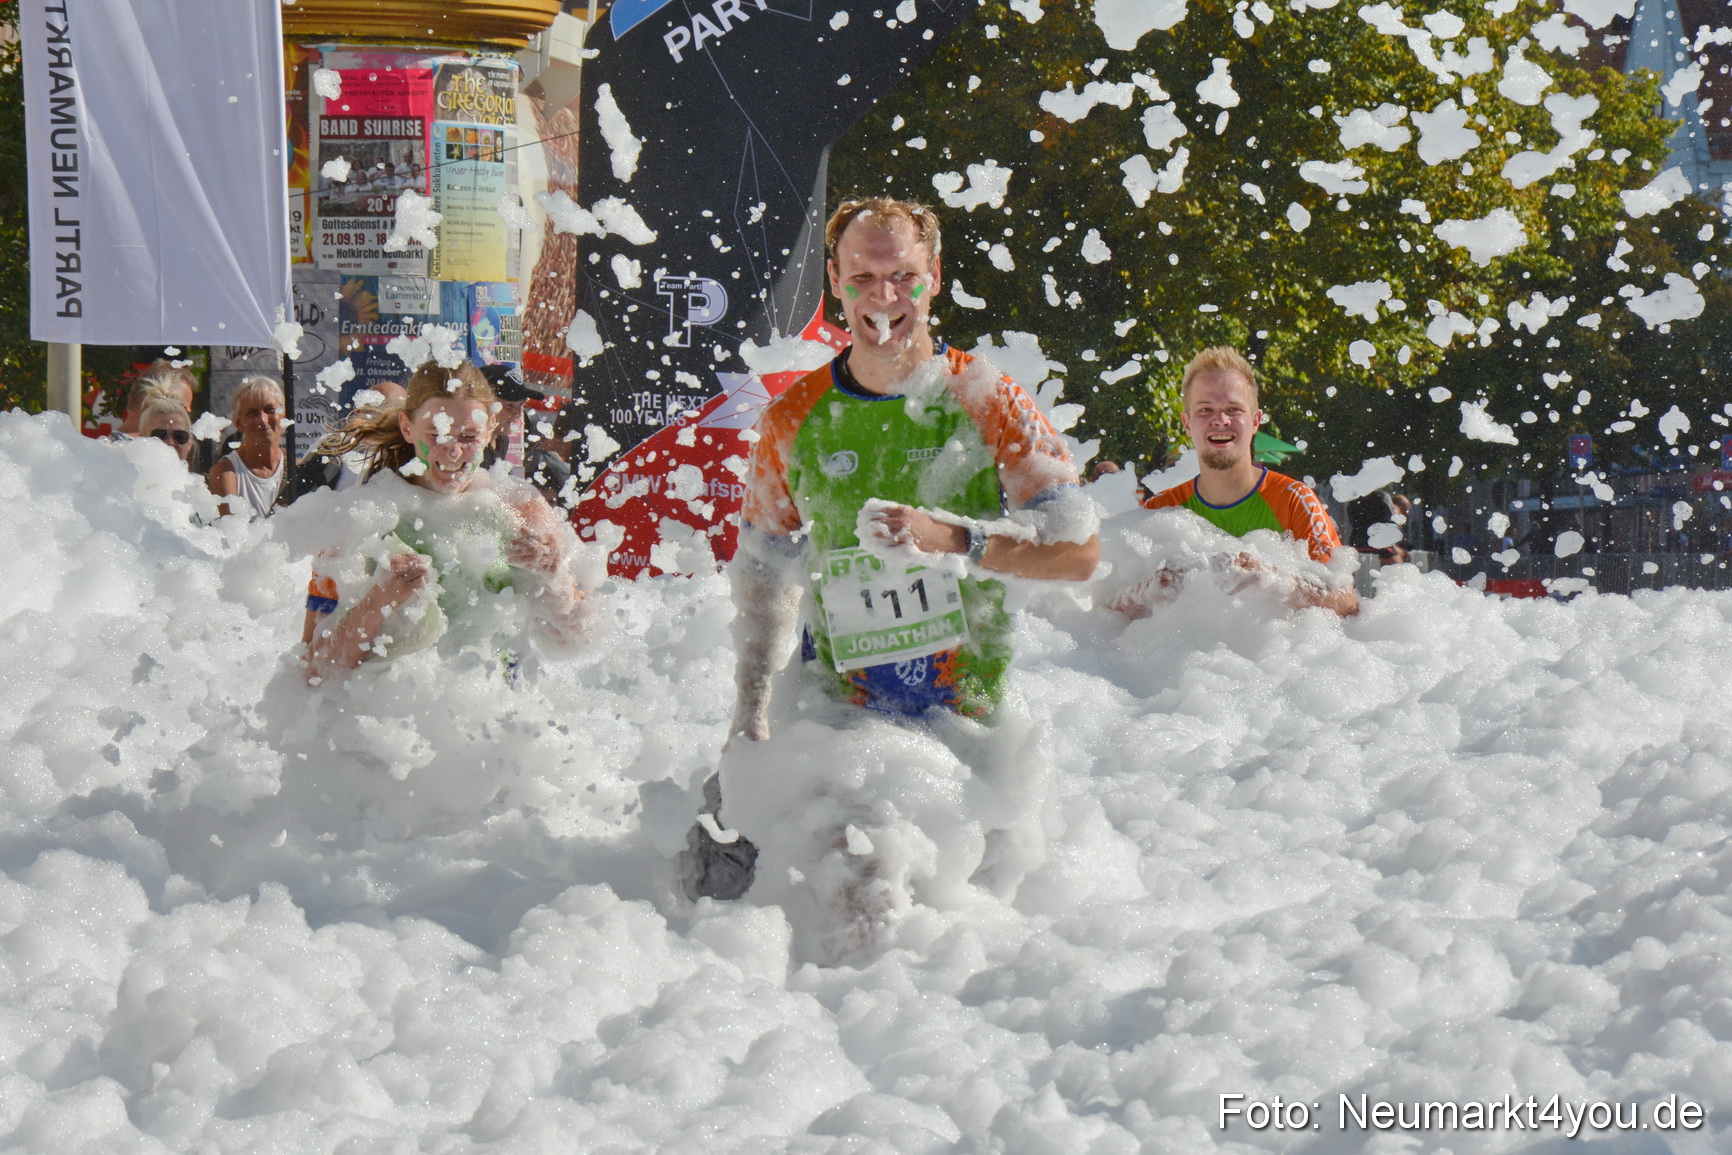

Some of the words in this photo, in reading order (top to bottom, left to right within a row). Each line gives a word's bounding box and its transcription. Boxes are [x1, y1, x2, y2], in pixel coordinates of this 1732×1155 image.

[663, 0, 768, 64] PAR
[321, 118, 358, 136] BAND
[364, 118, 422, 137] SUNRISE
[366, 197, 383, 213] 20
[322, 219, 381, 230] Gottesdienst
[322, 233, 366, 246] 21.09.19
[336, 248, 380, 260] Hofkirche
[381, 248, 424, 260] Neumarkt
[660, 281, 683, 290] Team
[341, 320, 443, 337] Erntedankf
[367, 367, 401, 377] Oktober
[632, 393, 662, 409] THE
[665, 395, 708, 411] NEXT
[610, 408, 633, 425] 100
[635, 409, 688, 427] YEARS
[859, 577, 930, 620] 111
[846, 617, 955, 656] JONATHAN
